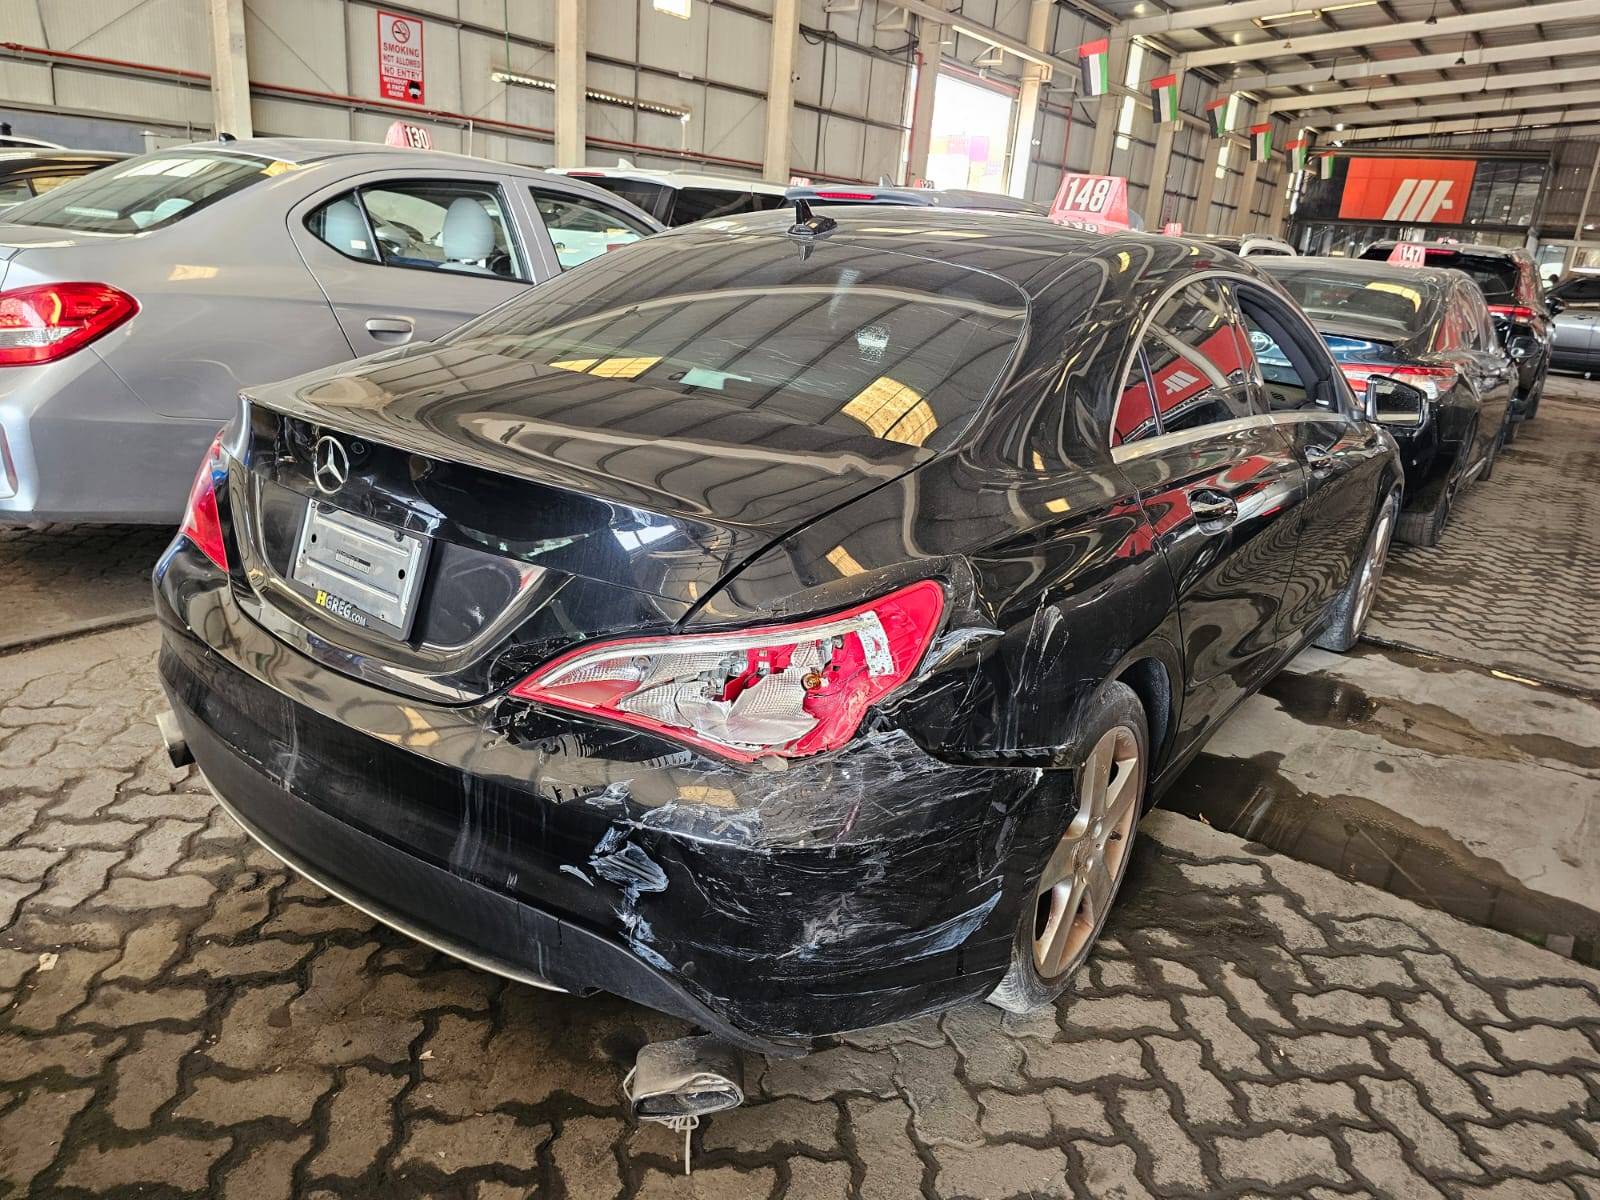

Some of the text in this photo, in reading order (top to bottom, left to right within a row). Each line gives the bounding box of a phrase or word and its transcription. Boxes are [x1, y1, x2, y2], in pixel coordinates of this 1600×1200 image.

[384, 42, 419, 57] SMOKING
[383, 54, 420, 68] NOT ALLOWED
[385, 66, 420, 80] NO ENTRY
[405, 126, 429, 149] 130
[1063, 177, 1111, 212] 148
[1402, 245, 1420, 263] 147
